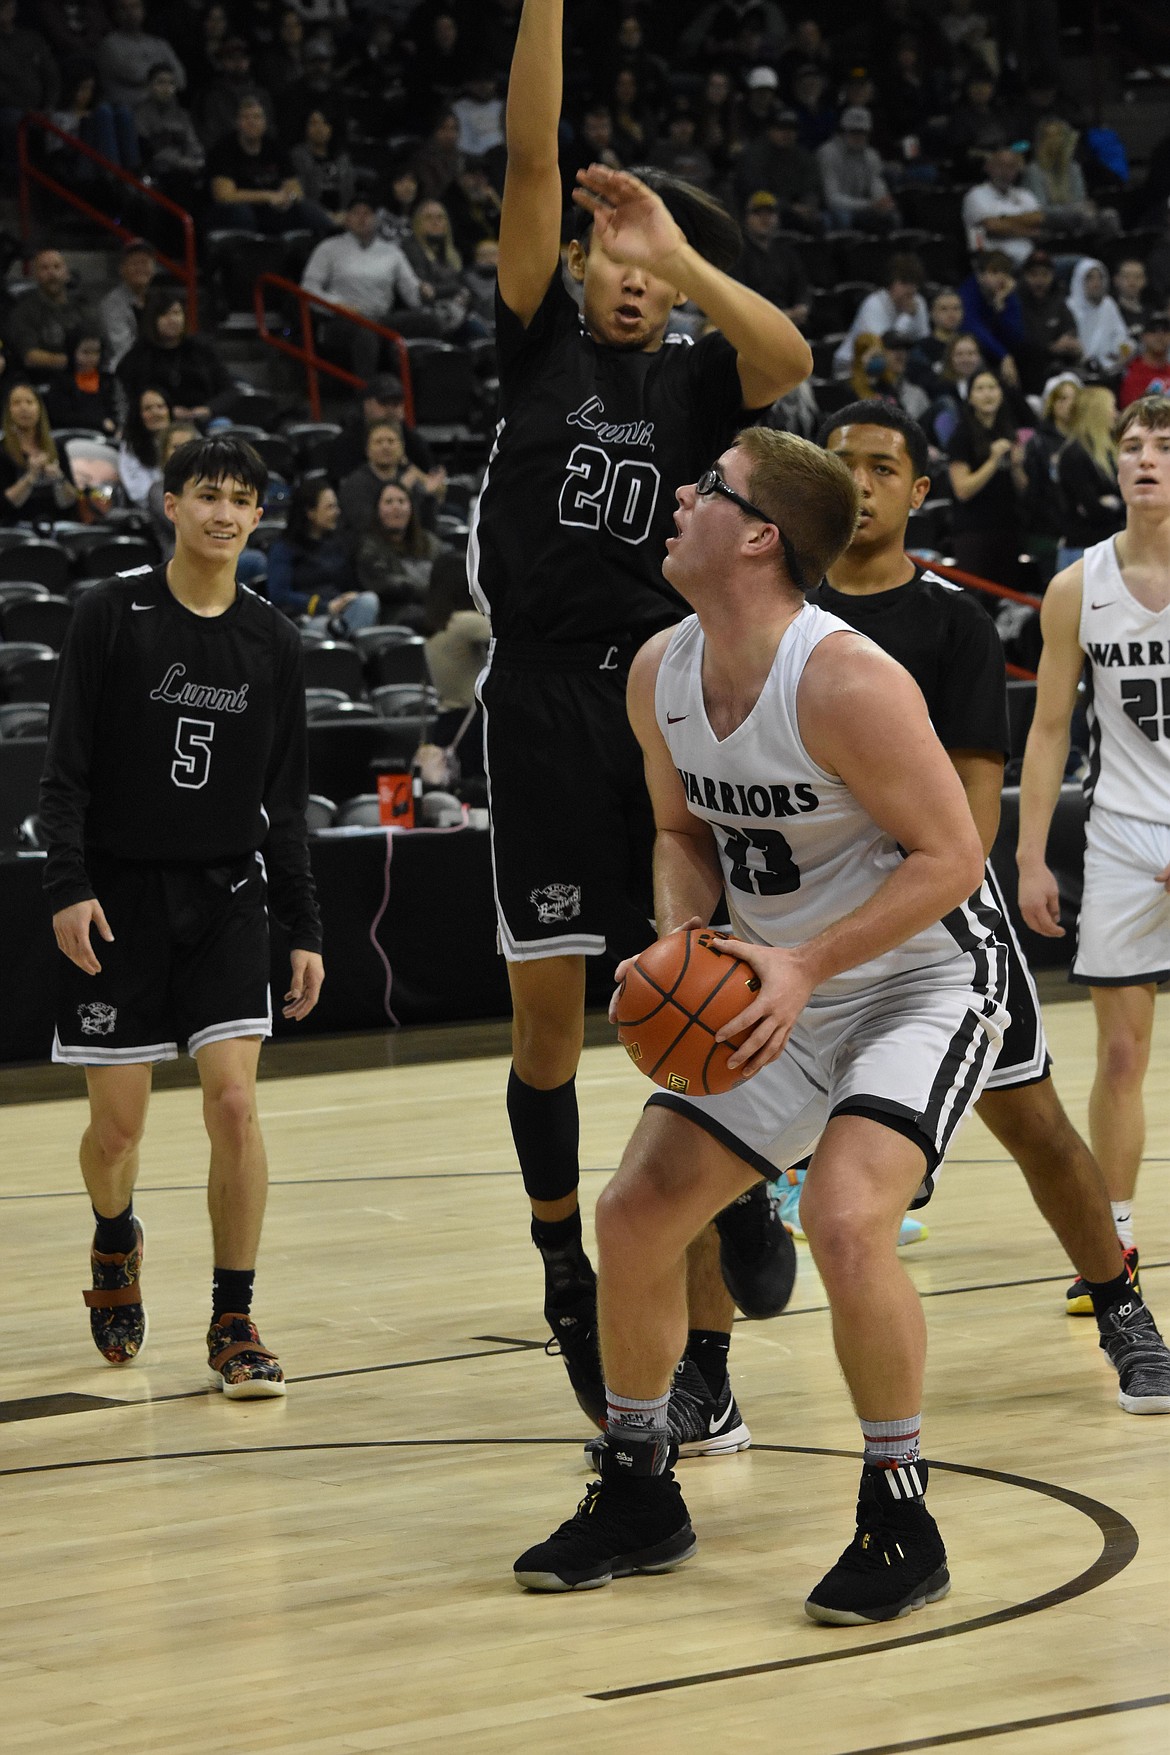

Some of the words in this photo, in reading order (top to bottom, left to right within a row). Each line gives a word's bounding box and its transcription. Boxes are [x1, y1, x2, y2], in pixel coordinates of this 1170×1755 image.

[558, 443, 661, 545] 20
[1087, 640, 1170, 667] WARR
[150, 662, 249, 713] Lummi
[1120, 677, 1170, 742] 2
[171, 717, 215, 789] 5
